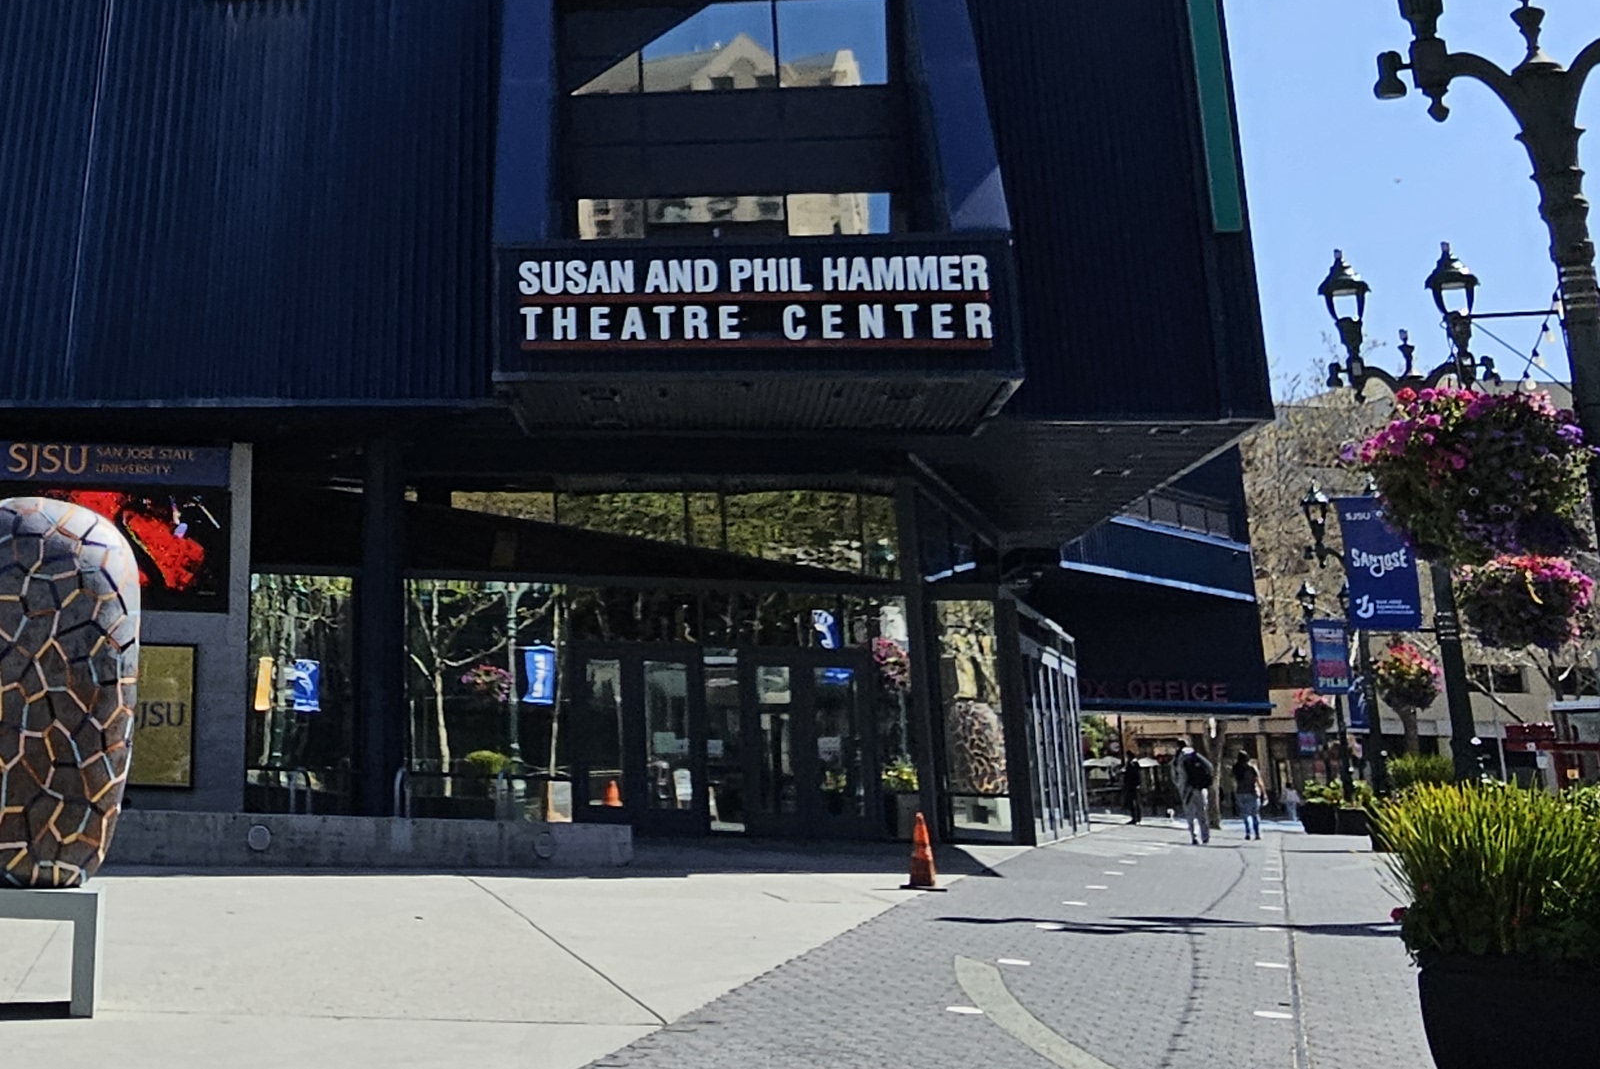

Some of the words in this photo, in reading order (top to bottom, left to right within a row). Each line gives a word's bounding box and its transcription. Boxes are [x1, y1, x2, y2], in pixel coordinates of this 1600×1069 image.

[518, 259, 635, 295] SUSAN
[644, 258, 719, 293] AND
[730, 257, 813, 292] PHIL
[823, 255, 990, 292] HAMMER
[519, 305, 741, 341] THEATRE
[782, 302, 994, 341] CENTER
[7, 442, 90, 478] SJSU
[96, 446, 123, 458] SAN
[159, 447, 195, 461] STATE
[96, 462, 171, 475] UNIVERSITY
[1345, 511, 1371, 521] SJSU
[1079, 677, 1109, 698] OX
[1128, 678, 1228, 702] OFFICE
[1318, 677, 1349, 688] FILM
[134, 701, 185, 729] JSU
